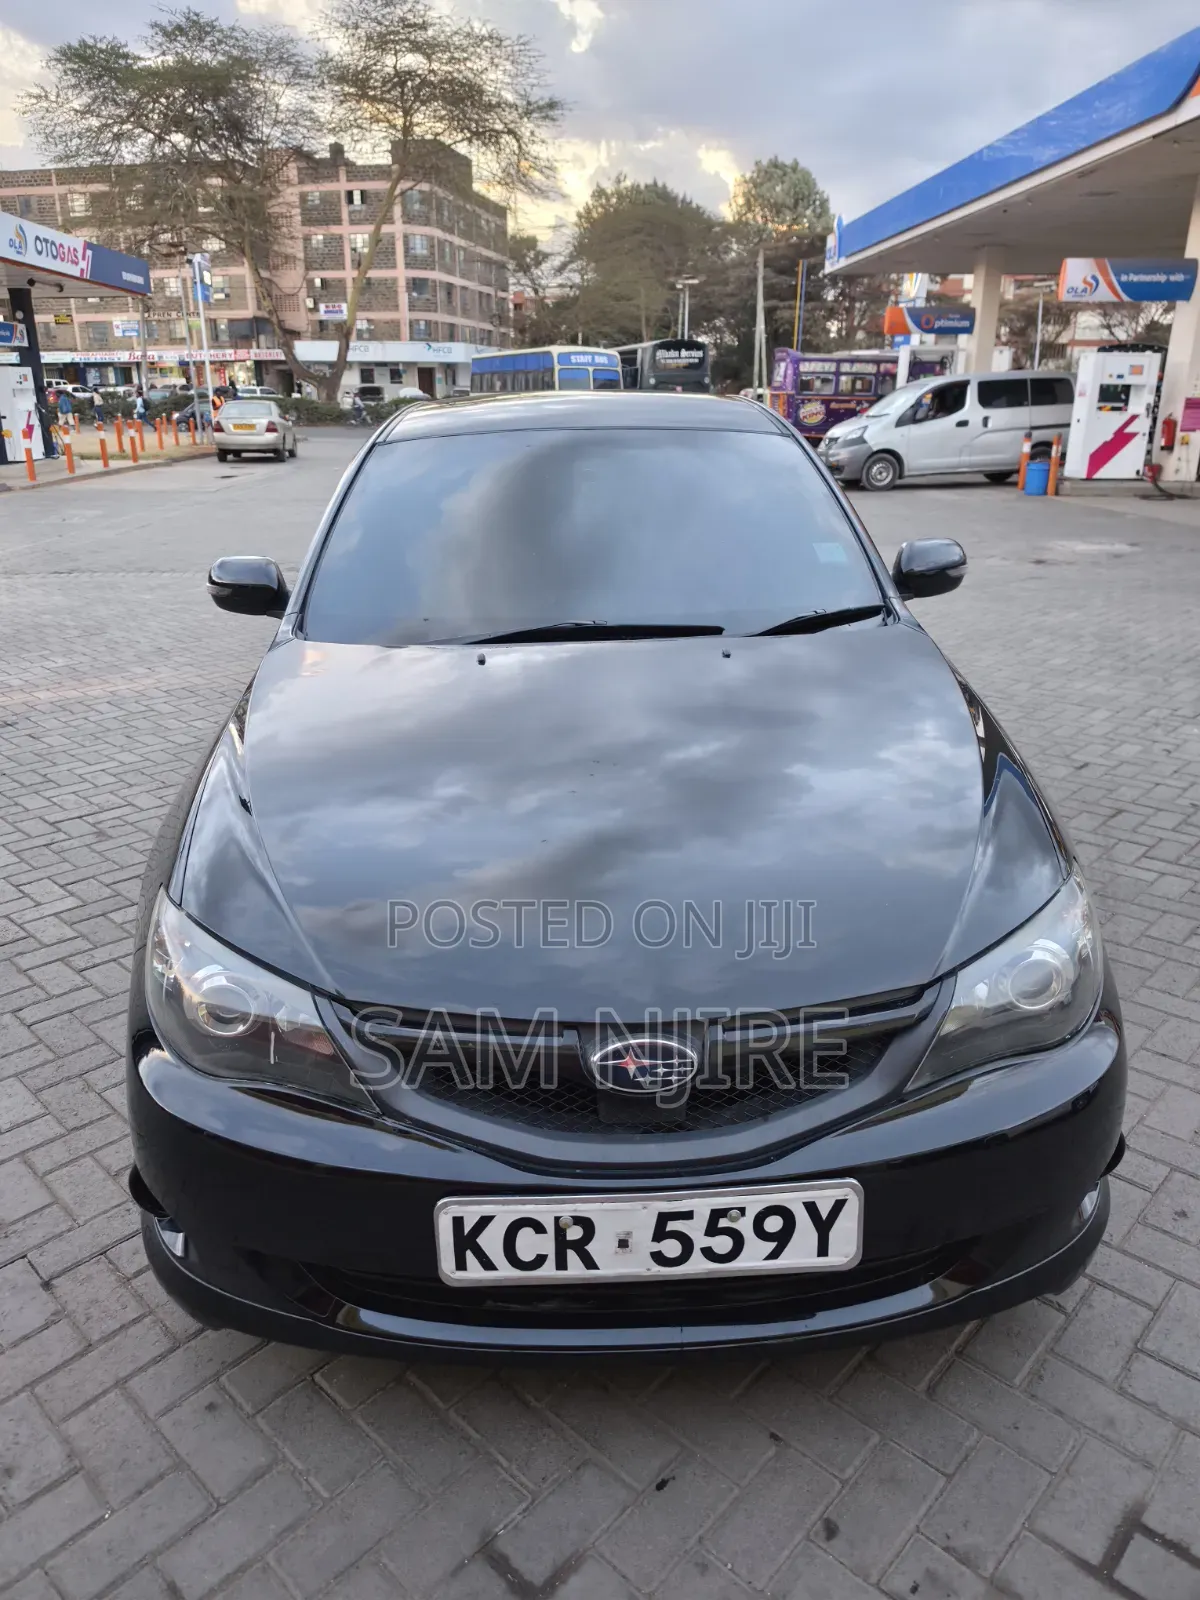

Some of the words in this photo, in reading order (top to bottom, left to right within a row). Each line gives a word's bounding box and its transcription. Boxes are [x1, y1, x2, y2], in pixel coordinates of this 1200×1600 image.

[9, 238, 22, 249] OLA
[34, 235, 80, 266] OTOGAS
[1066, 286, 1088, 294] OLA
[570, 354, 592, 363] STAFF
[452, 1214, 600, 1272] KCR
[649, 1198, 848, 1268] 559Y
